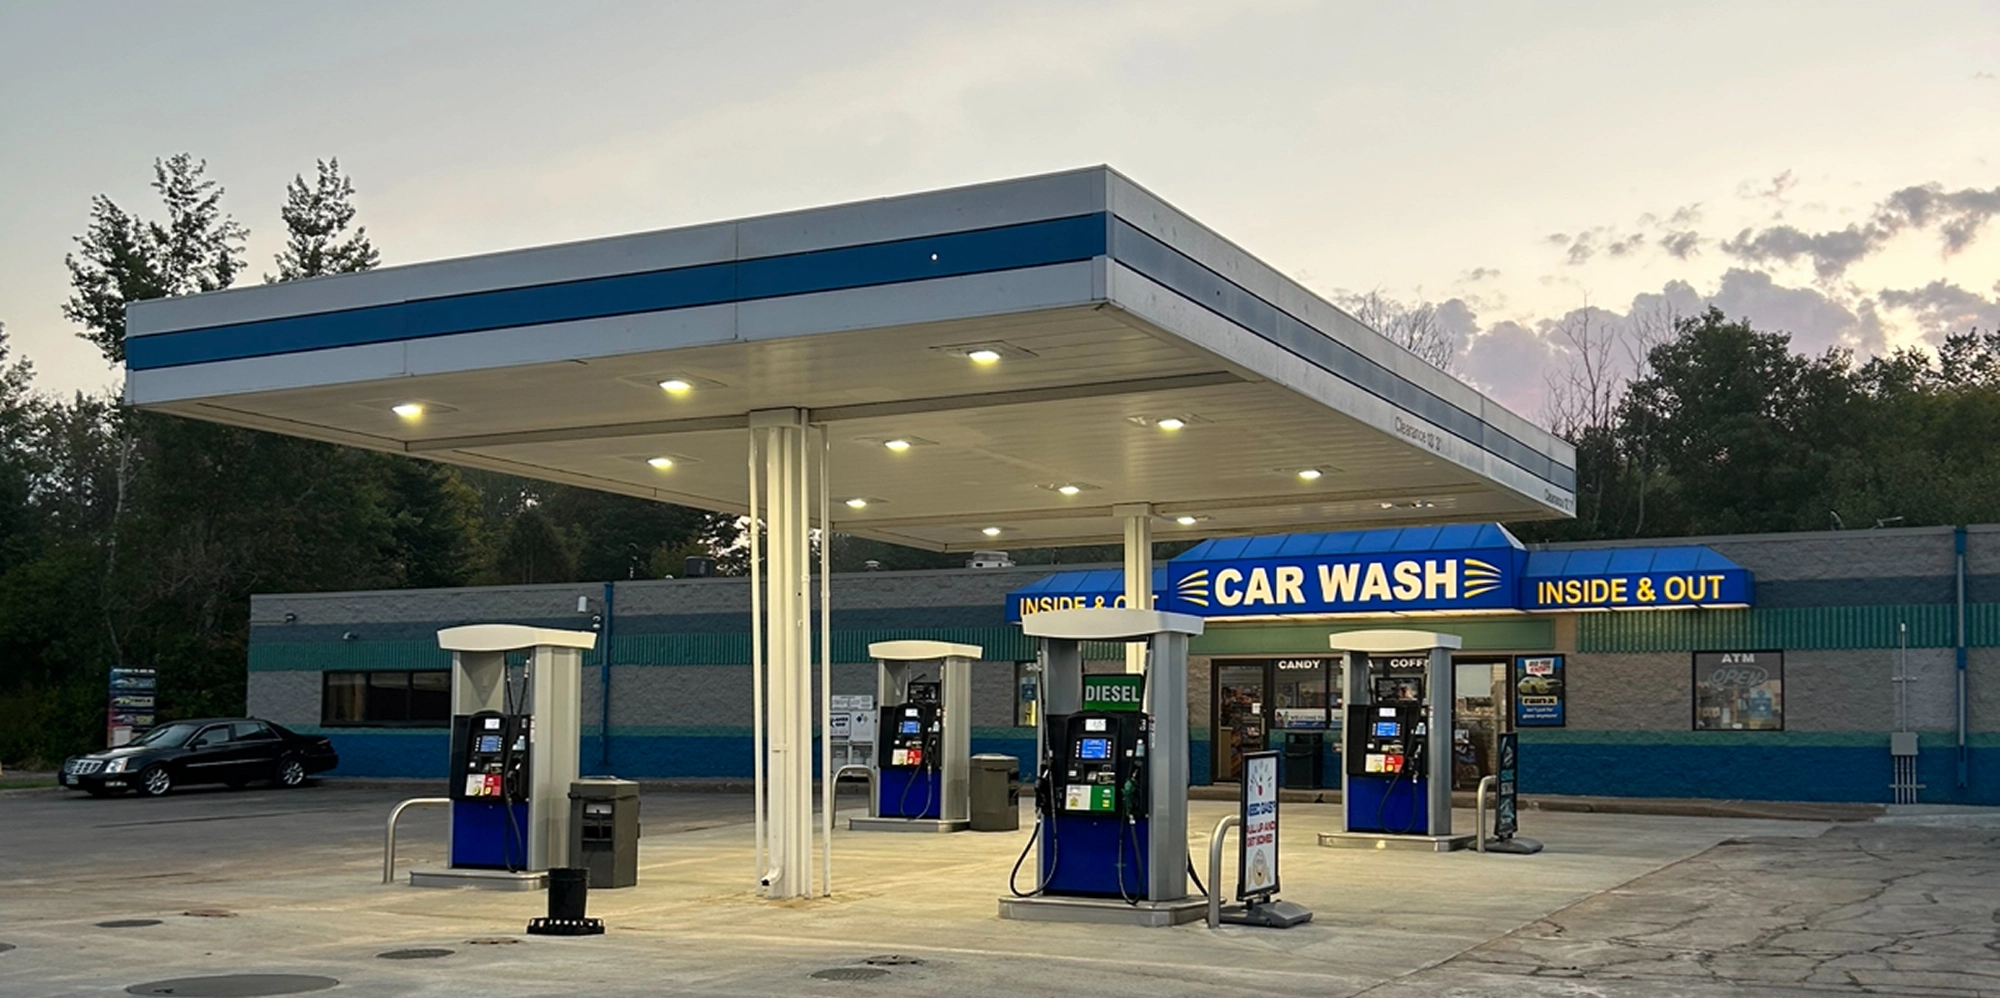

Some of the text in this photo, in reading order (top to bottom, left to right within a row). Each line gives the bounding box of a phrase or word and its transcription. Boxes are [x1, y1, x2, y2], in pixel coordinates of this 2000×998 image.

[1214, 559, 1458, 607] CAR WASH
[1538, 575, 1725, 605] INSIDE & OUT
[1278, 660, 1321, 669] CANDY
[1721, 653, 1755, 663] ATM
[1711, 668, 1763, 686] OPEN
[1084, 685, 1140, 702] DIESEL
